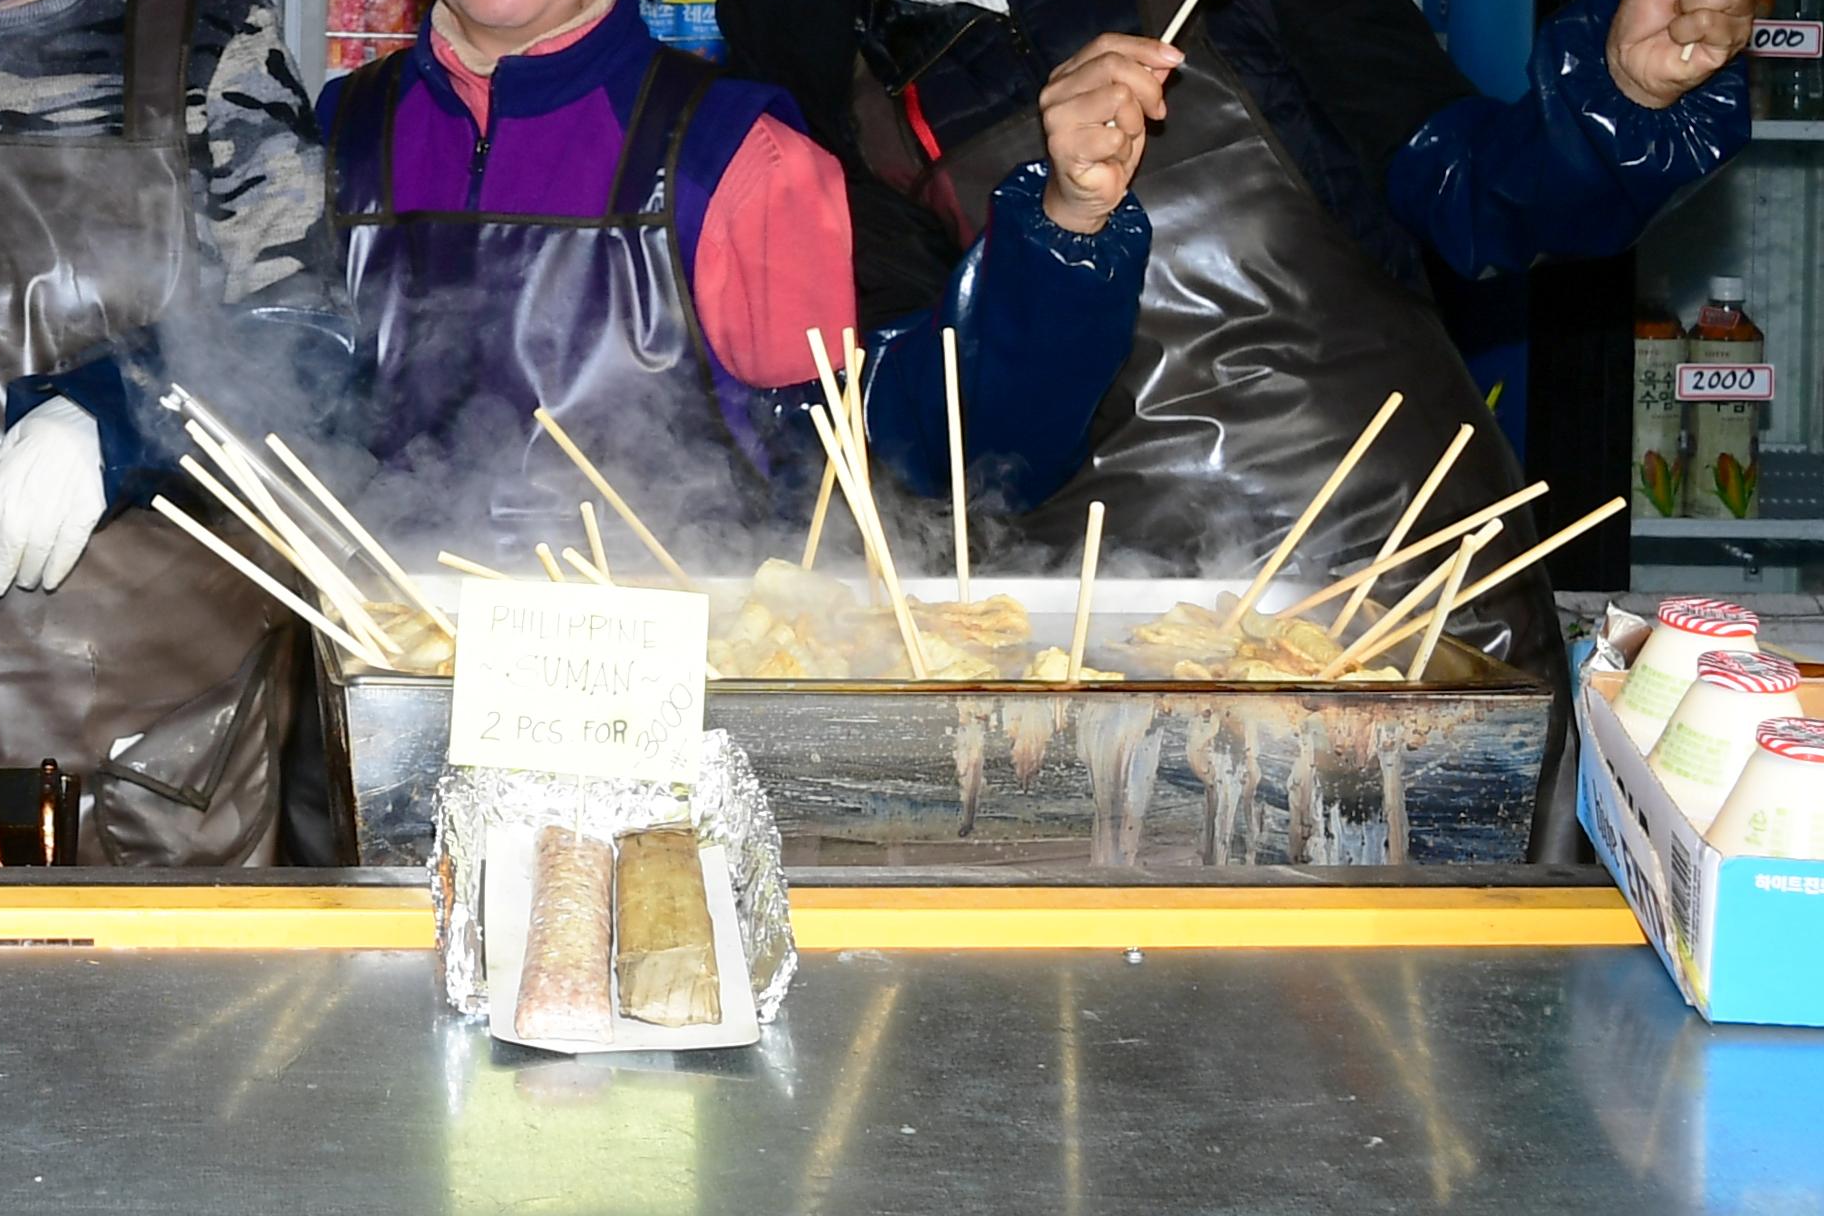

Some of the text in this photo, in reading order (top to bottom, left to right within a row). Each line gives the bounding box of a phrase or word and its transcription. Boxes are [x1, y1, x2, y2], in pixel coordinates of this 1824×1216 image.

[1747, 28, 1805, 48] 000
[1640, 370, 1676, 390] 옥수
[1692, 368, 1755, 390] 2000
[1638, 390, 1675, 411] 수염
[490, 605, 657, 649] PHILIPPINE
[480, 711, 502, 742] 2
[516, 715, 564, 745] PCS
[583, 719, 627, 745] FOR
